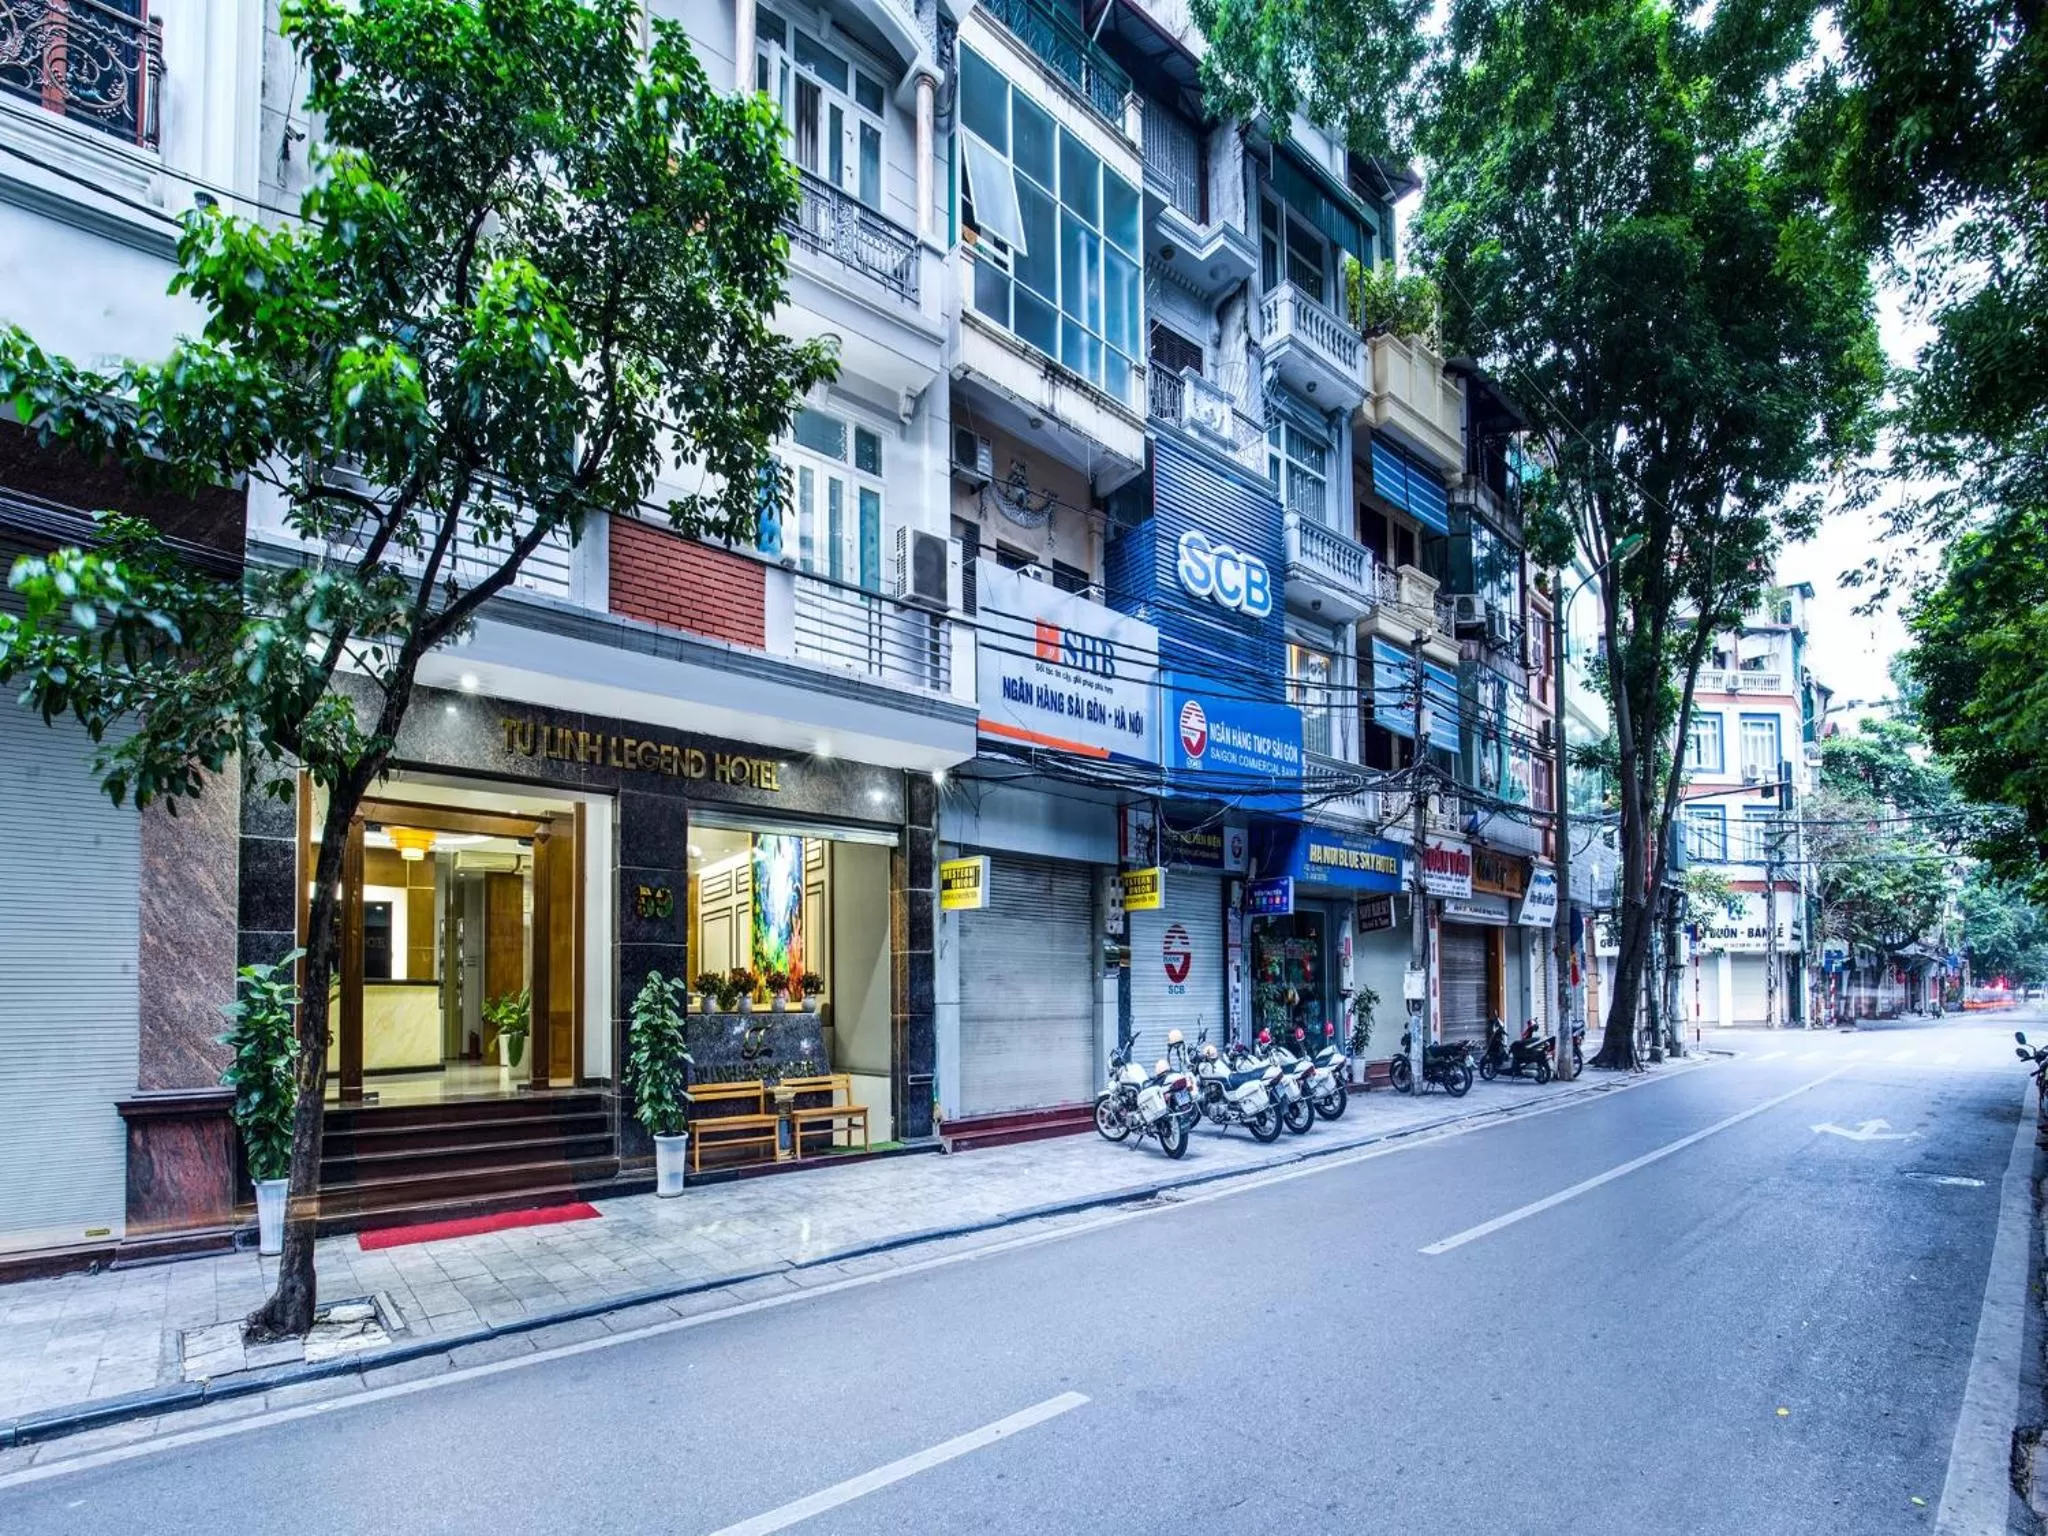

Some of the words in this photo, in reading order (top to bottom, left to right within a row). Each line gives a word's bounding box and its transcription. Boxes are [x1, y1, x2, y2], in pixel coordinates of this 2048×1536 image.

[1179, 531, 1272, 616] SCB
[1063, 628, 1115, 679] SHB
[1003, 676, 1033, 706] NGÂN
[1036, 684, 1065, 714] HÀNG
[1067, 692, 1085, 720] SÀI
[1087, 697, 1106, 725] GÒN
[1113, 705, 1127, 732] HÀ
[1128, 710, 1144, 739] NỘI
[501, 719, 535, 757] TU
[543, 725, 602, 765] LINH
[608, 736, 707, 780] LEGEND
[714, 752, 781, 792] HOTEL
[1209, 721, 1231, 746] NGÂN
[1232, 726, 1252, 752] HÀNG
[1272, 737, 1284, 760] SÀI
[1284, 741, 1298, 764] GÒN
[1210, 746, 1238, 765] SAIGON
[1238, 754, 1281, 777] COMMERCIAL
[1339, 848, 1359, 869] BLUE
[1168, 984, 1185, 995] SCB
